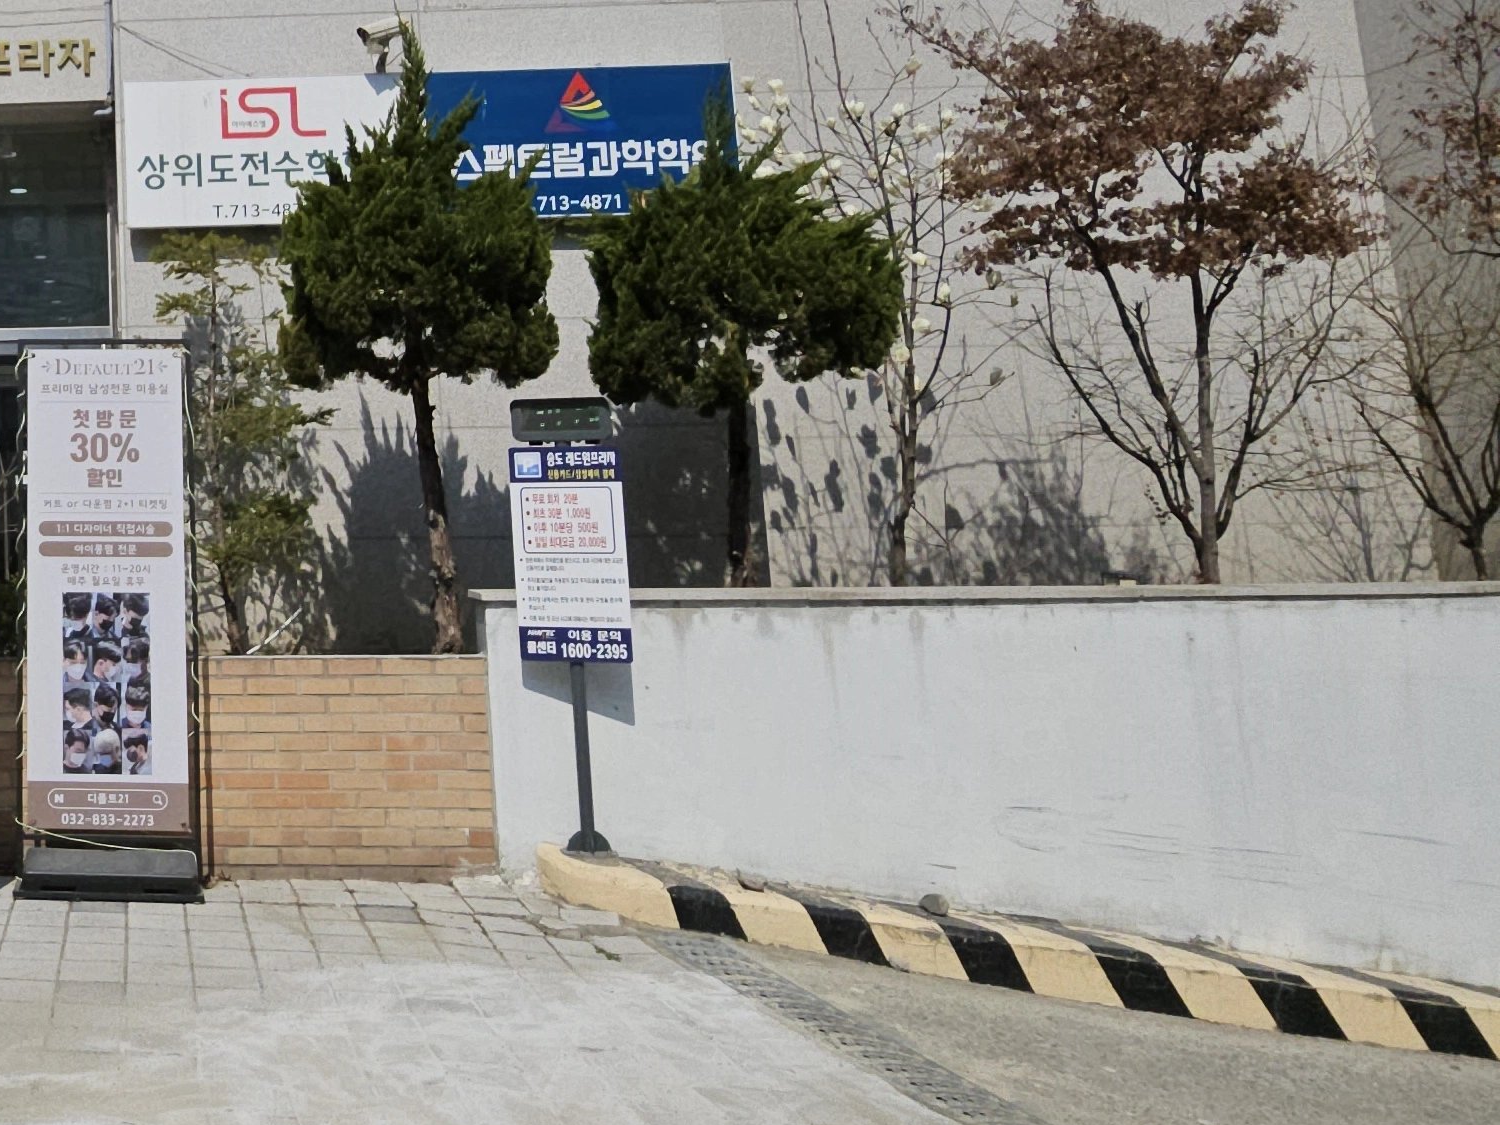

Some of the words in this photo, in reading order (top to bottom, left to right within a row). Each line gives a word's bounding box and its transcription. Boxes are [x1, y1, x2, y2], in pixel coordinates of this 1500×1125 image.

[536, 194, 622, 212] 713-4871
[54, 357, 155, 376] DEFAULT21
[40, 383, 83, 395] 프리미엄
[88, 383, 132, 395] 남성전문
[136, 383, 169, 395] 미용실
[69, 432, 140, 463] 30%
[86, 468, 123, 488] 할인
[73, 523, 112, 533] 디자이너
[567, 629, 592, 641] 이용
[561, 642, 628, 660] 1600-2395
[60, 813, 155, 827] 032-833-2273
